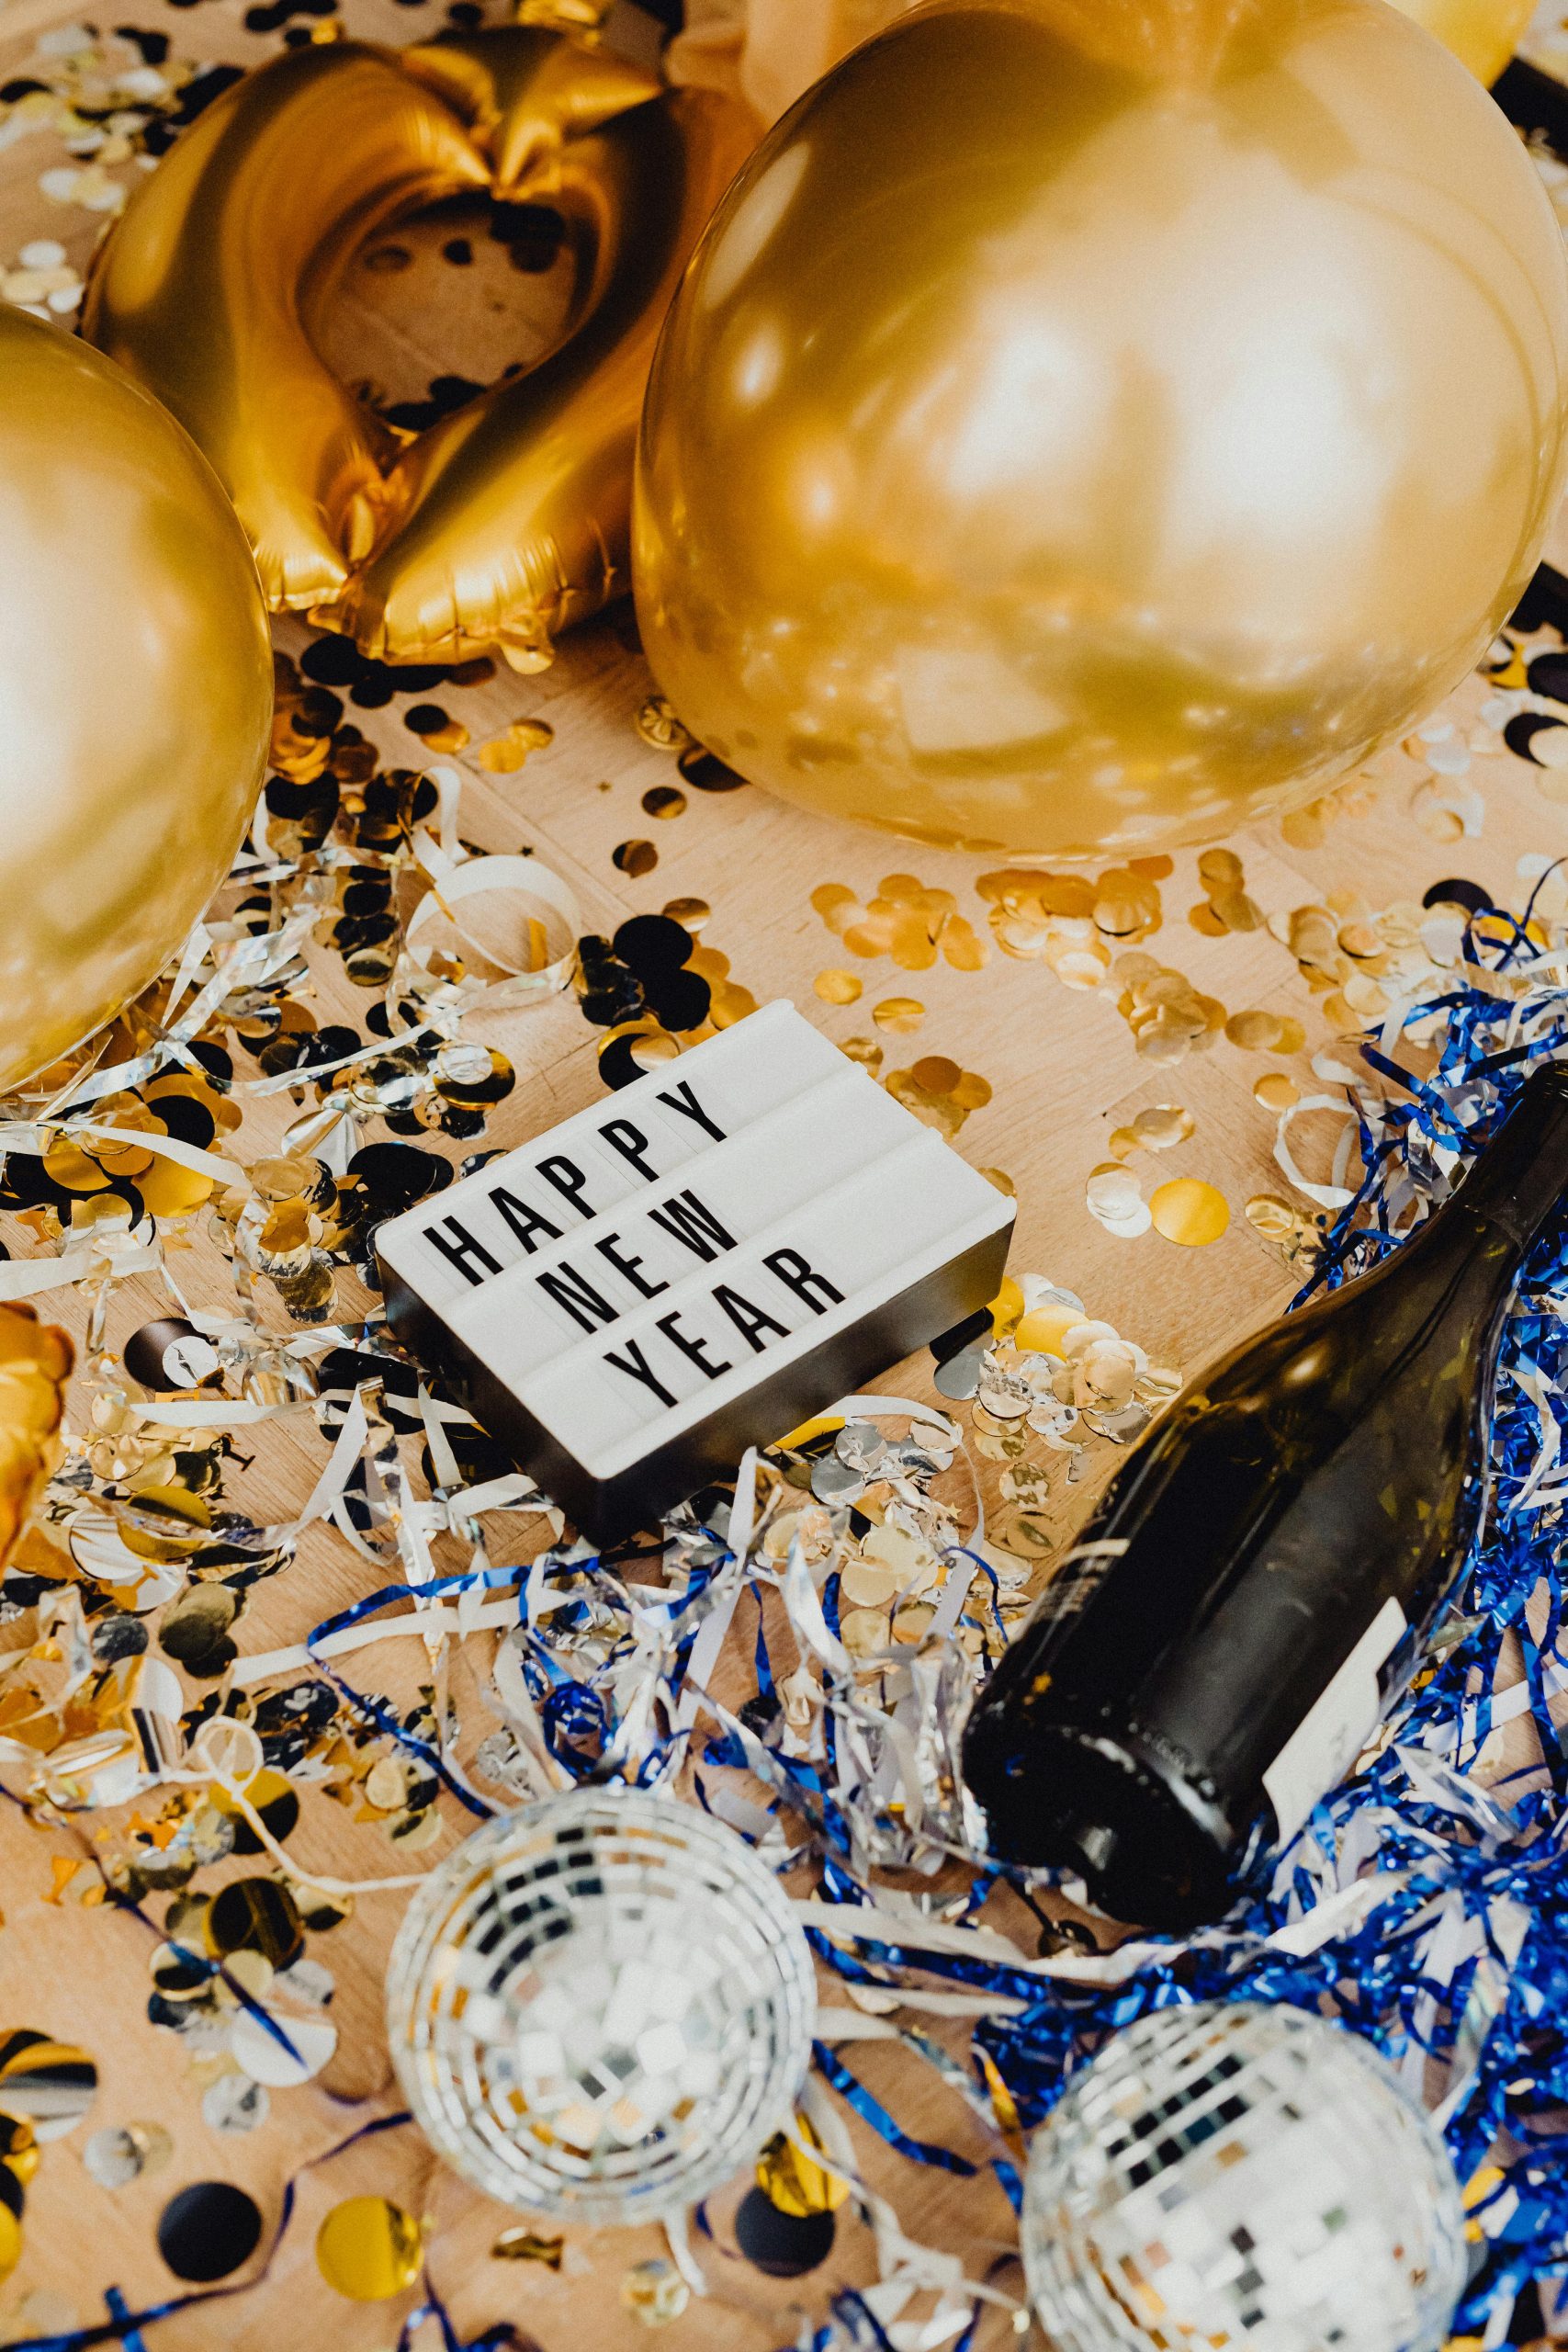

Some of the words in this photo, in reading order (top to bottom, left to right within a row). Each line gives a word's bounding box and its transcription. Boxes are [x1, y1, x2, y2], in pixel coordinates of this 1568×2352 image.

[422, 1080, 728, 1287] HAPPY
[535, 1188, 739, 1335] NEW
[602, 1248, 847, 1408] YEAR
